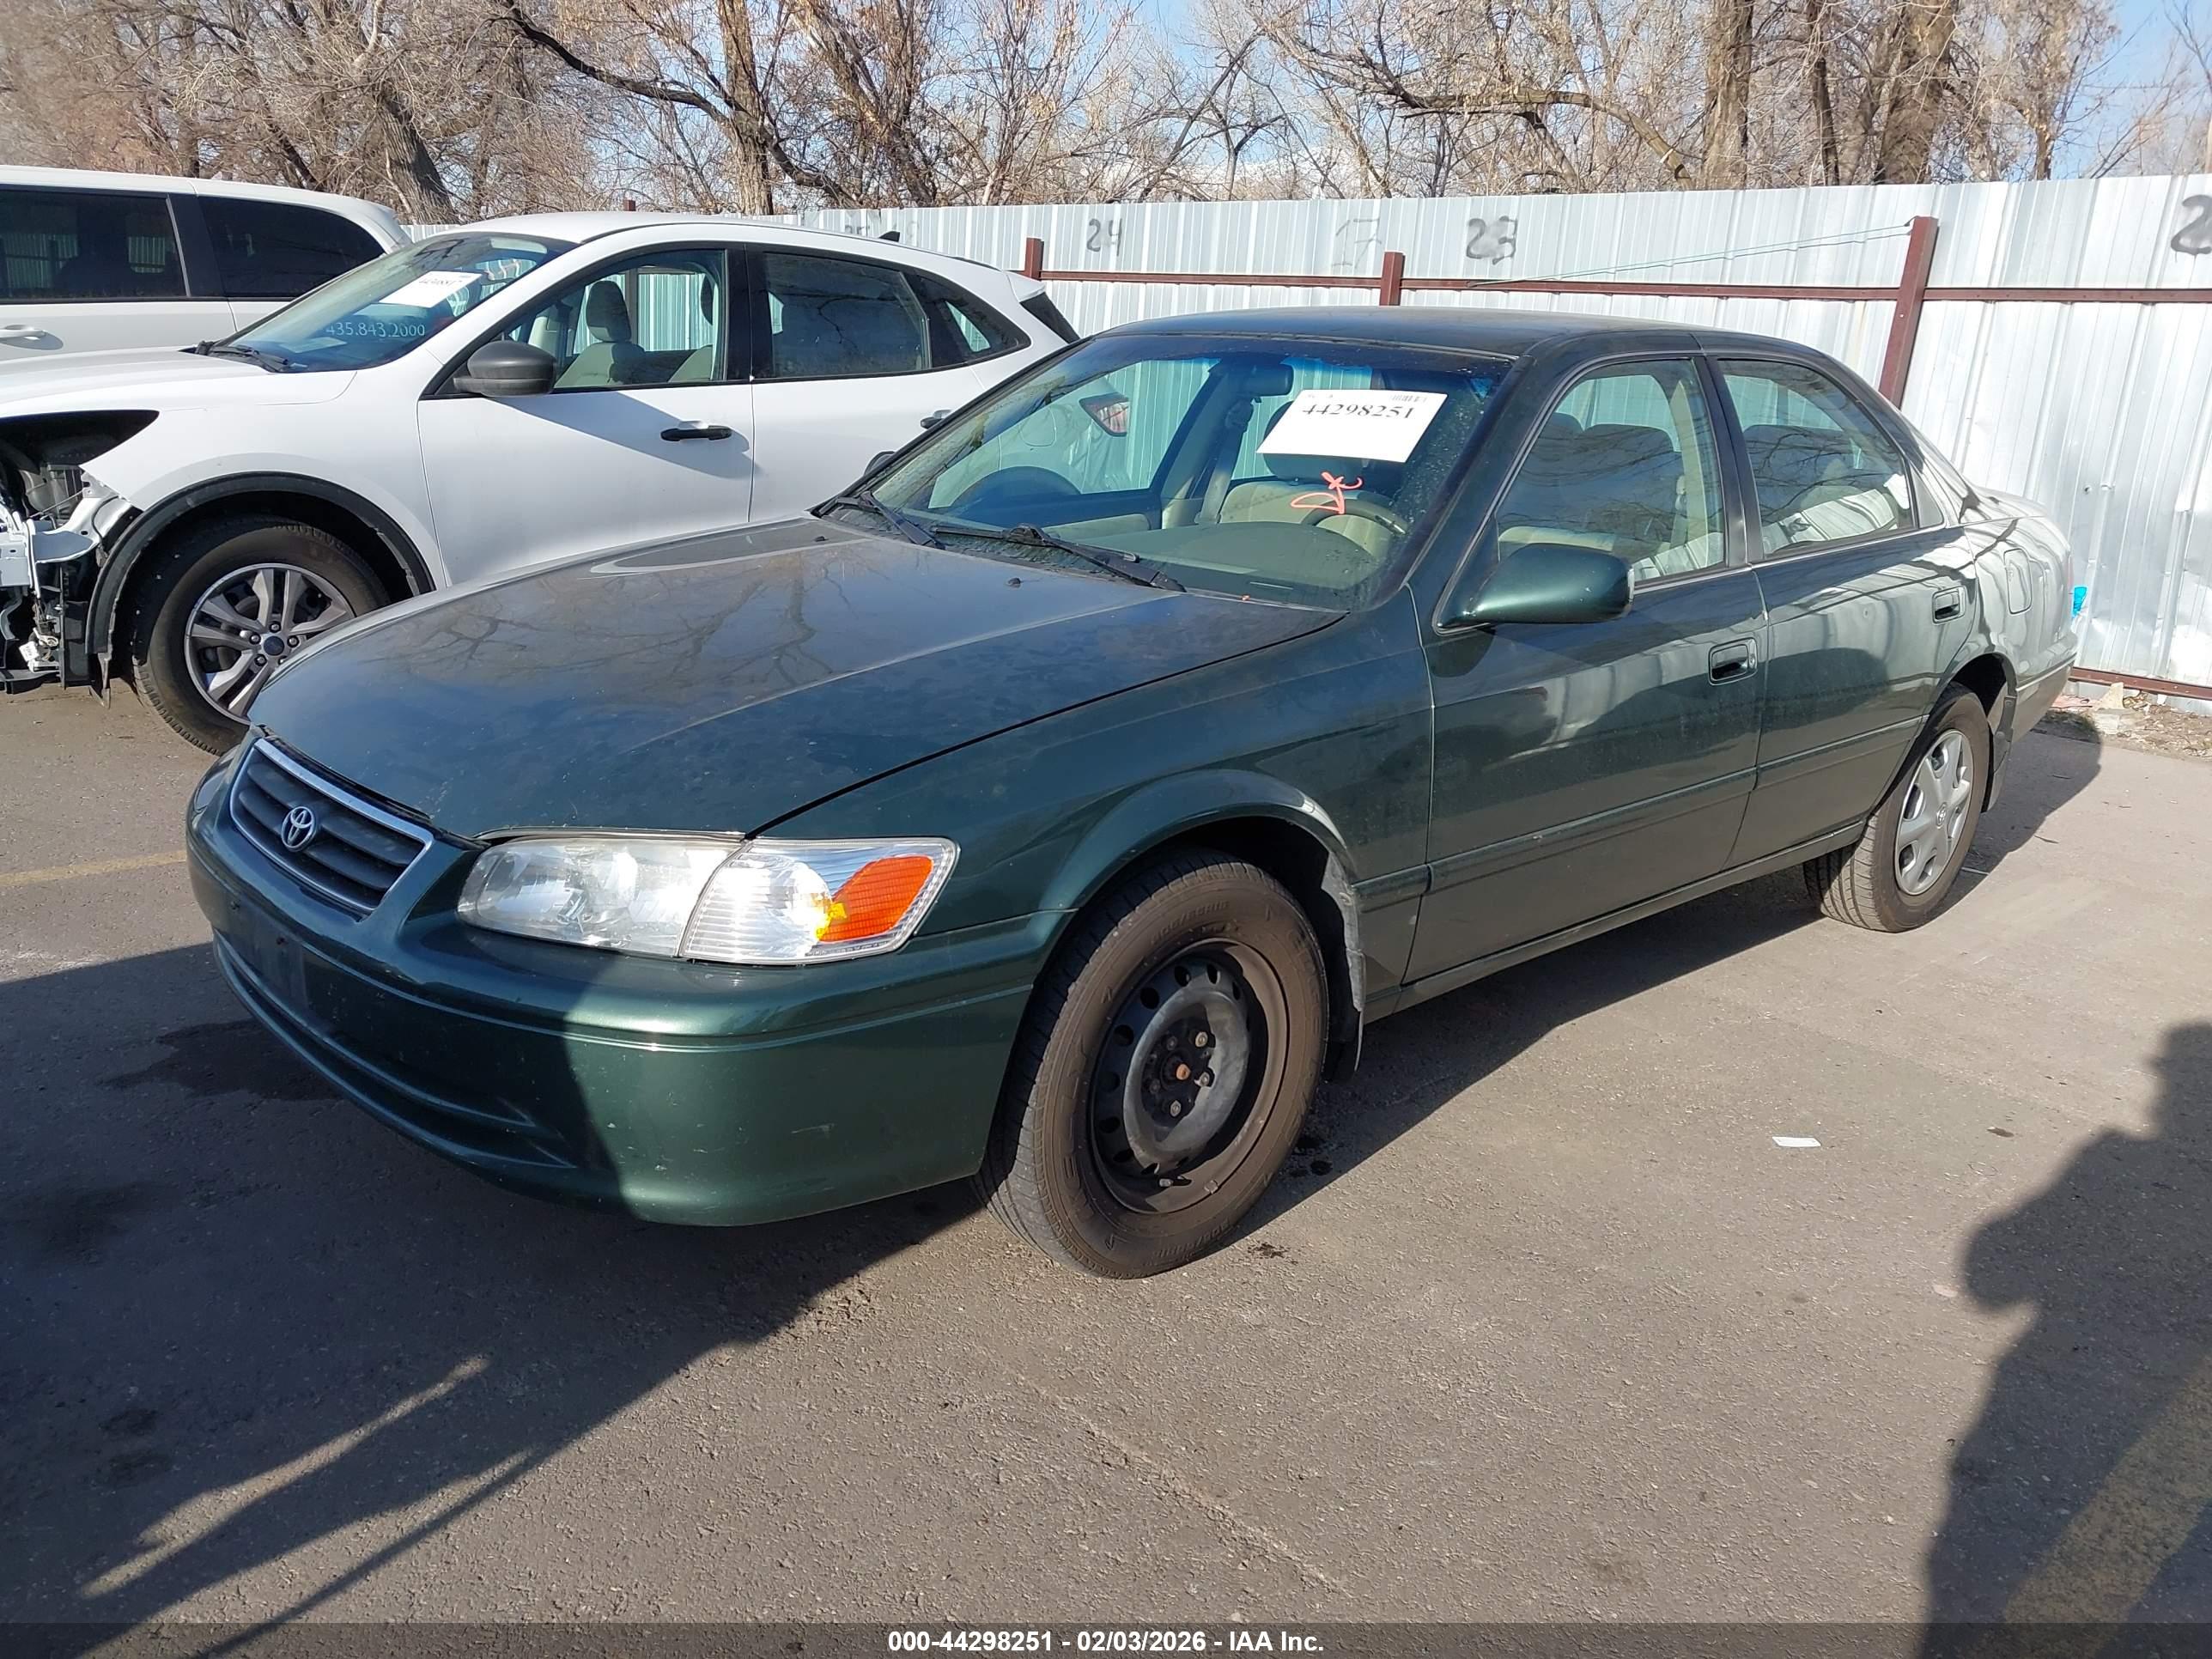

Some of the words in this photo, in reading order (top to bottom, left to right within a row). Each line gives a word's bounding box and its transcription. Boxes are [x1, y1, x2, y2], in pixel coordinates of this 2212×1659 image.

[1086, 218, 1122, 257] 24
[1467, 216, 1518, 265] 23
[325, 321, 425, 337] 435.843.2000
[1303, 403, 1415, 419] 44298251
